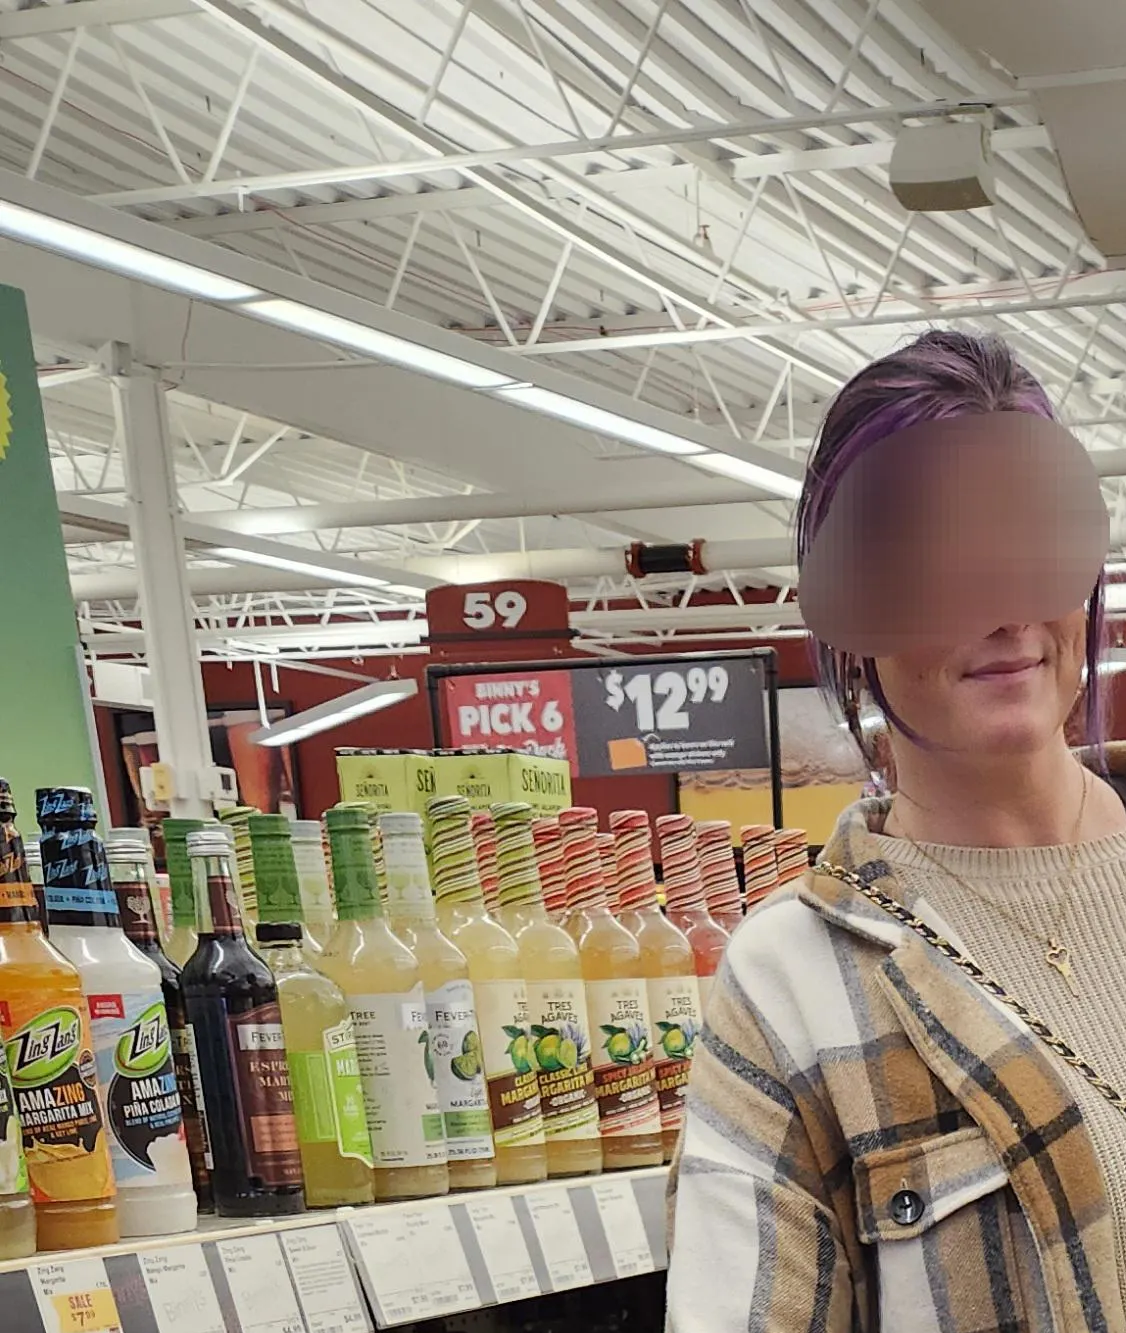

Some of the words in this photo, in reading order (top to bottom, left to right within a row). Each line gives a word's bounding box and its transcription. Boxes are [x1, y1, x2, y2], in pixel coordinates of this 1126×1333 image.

[463, 591, 527, 629] 59
[475, 680, 540, 700] BINNY'S
[459, 702, 535, 736] PICK
[541, 701, 564, 733] 6
[521, 765, 568, 797] SEÑORITA
[547, 1001, 572, 1011] TRES
[616, 1000, 638, 1010] TRES
[19, 1082, 86, 1113] AMAZING
[123, 1103, 148, 1118] PIÑA
[68, 1294, 93, 1309] SALE
